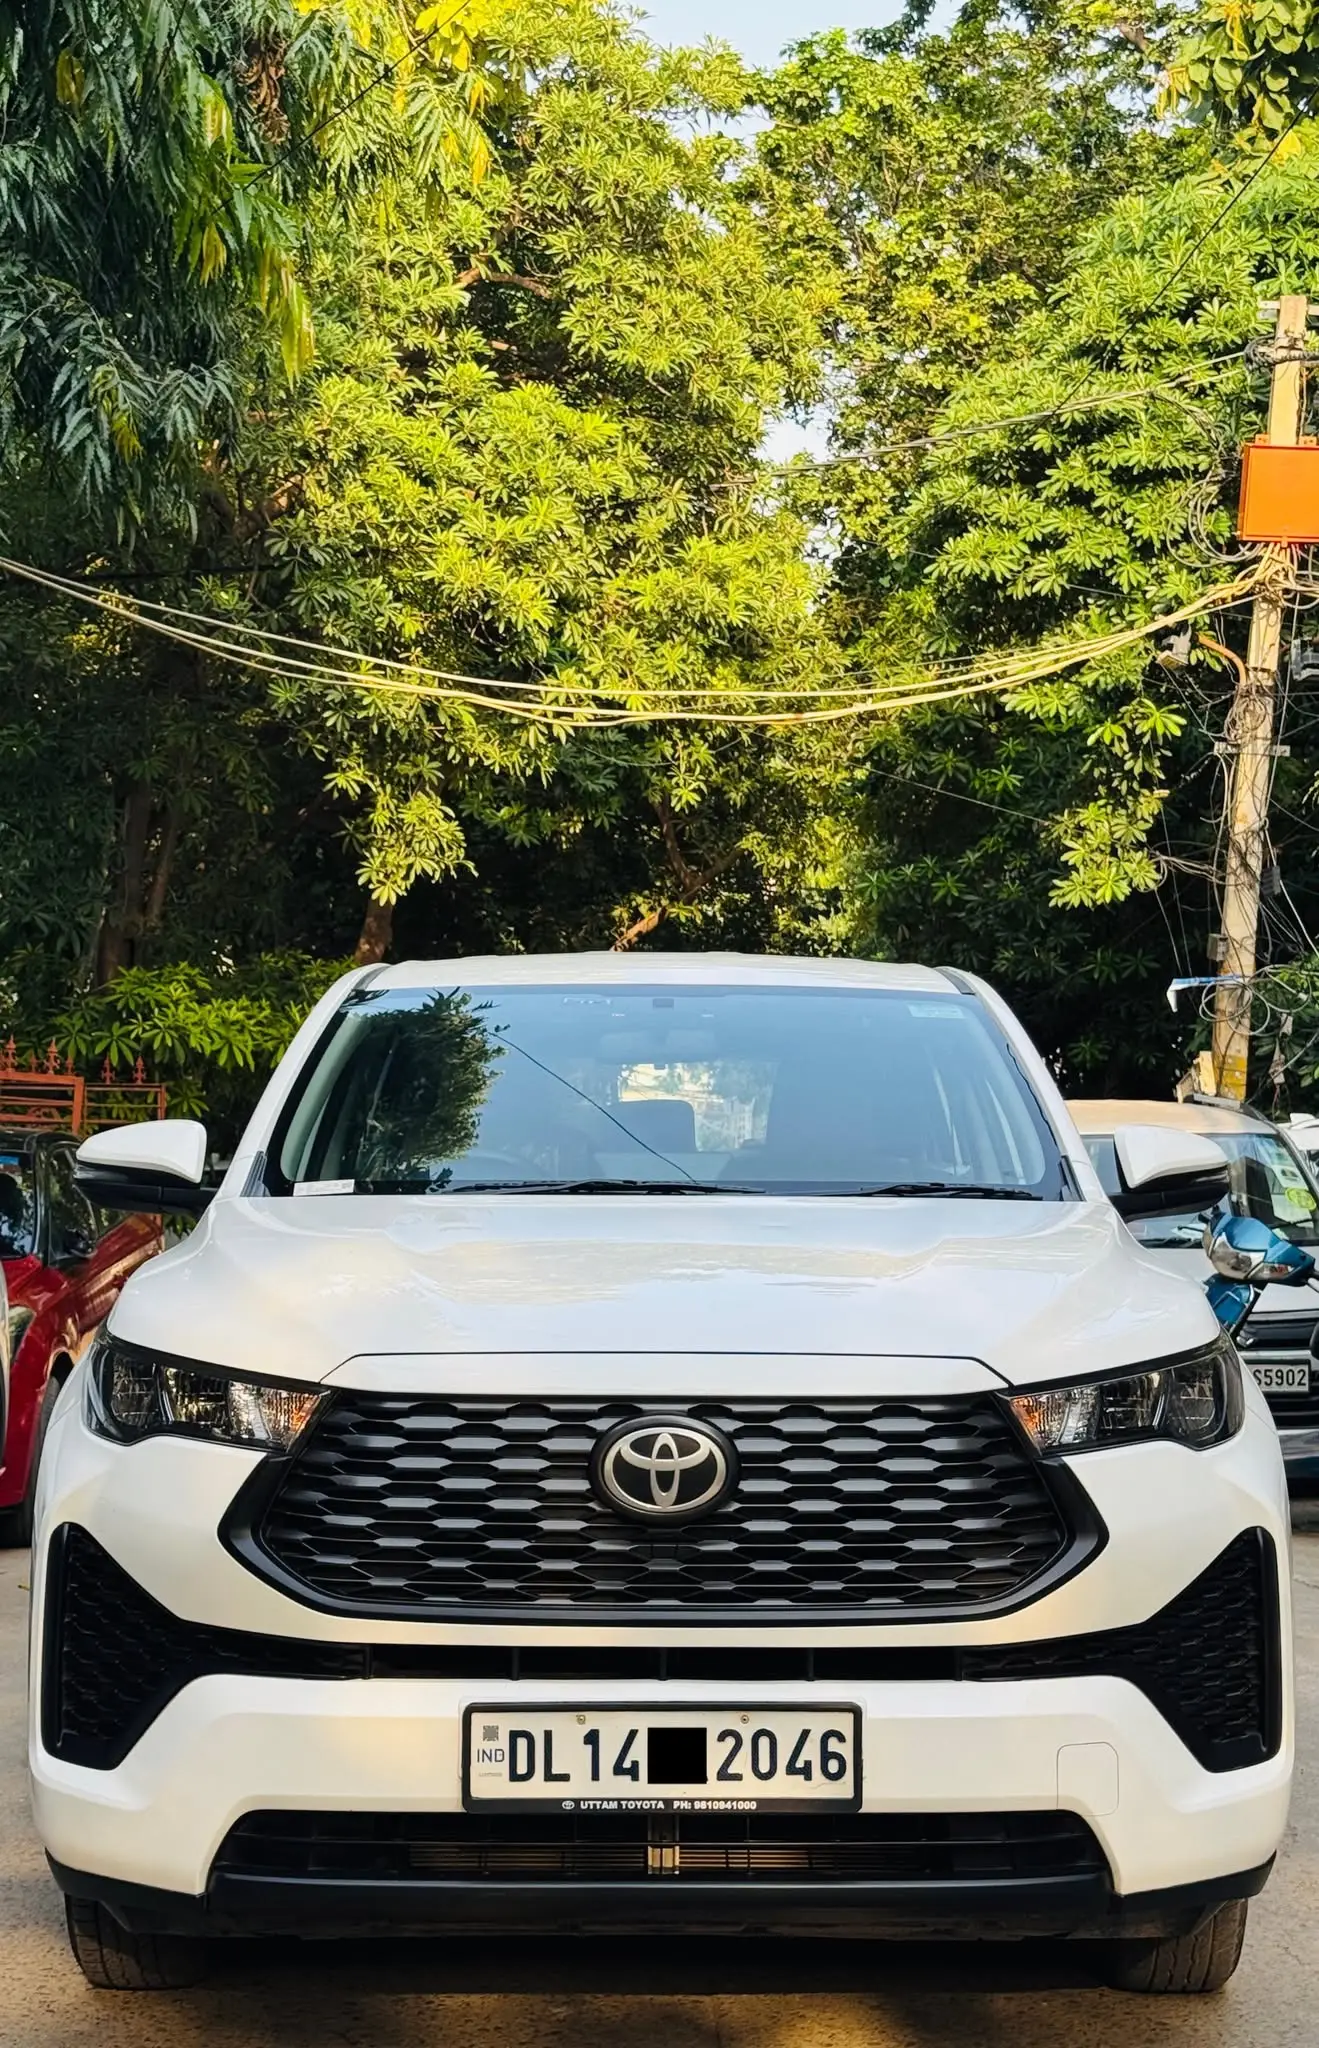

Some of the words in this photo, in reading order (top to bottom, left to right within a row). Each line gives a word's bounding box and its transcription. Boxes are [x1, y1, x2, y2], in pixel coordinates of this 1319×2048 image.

[477, 1748, 504, 1763] IND
[716, 1728, 846, 1781] 2046
[580, 1800, 617, 1810] UTTAM
[621, 1800, 664, 1810] TOYOTA
[673, 1800, 691, 1810] PH:
